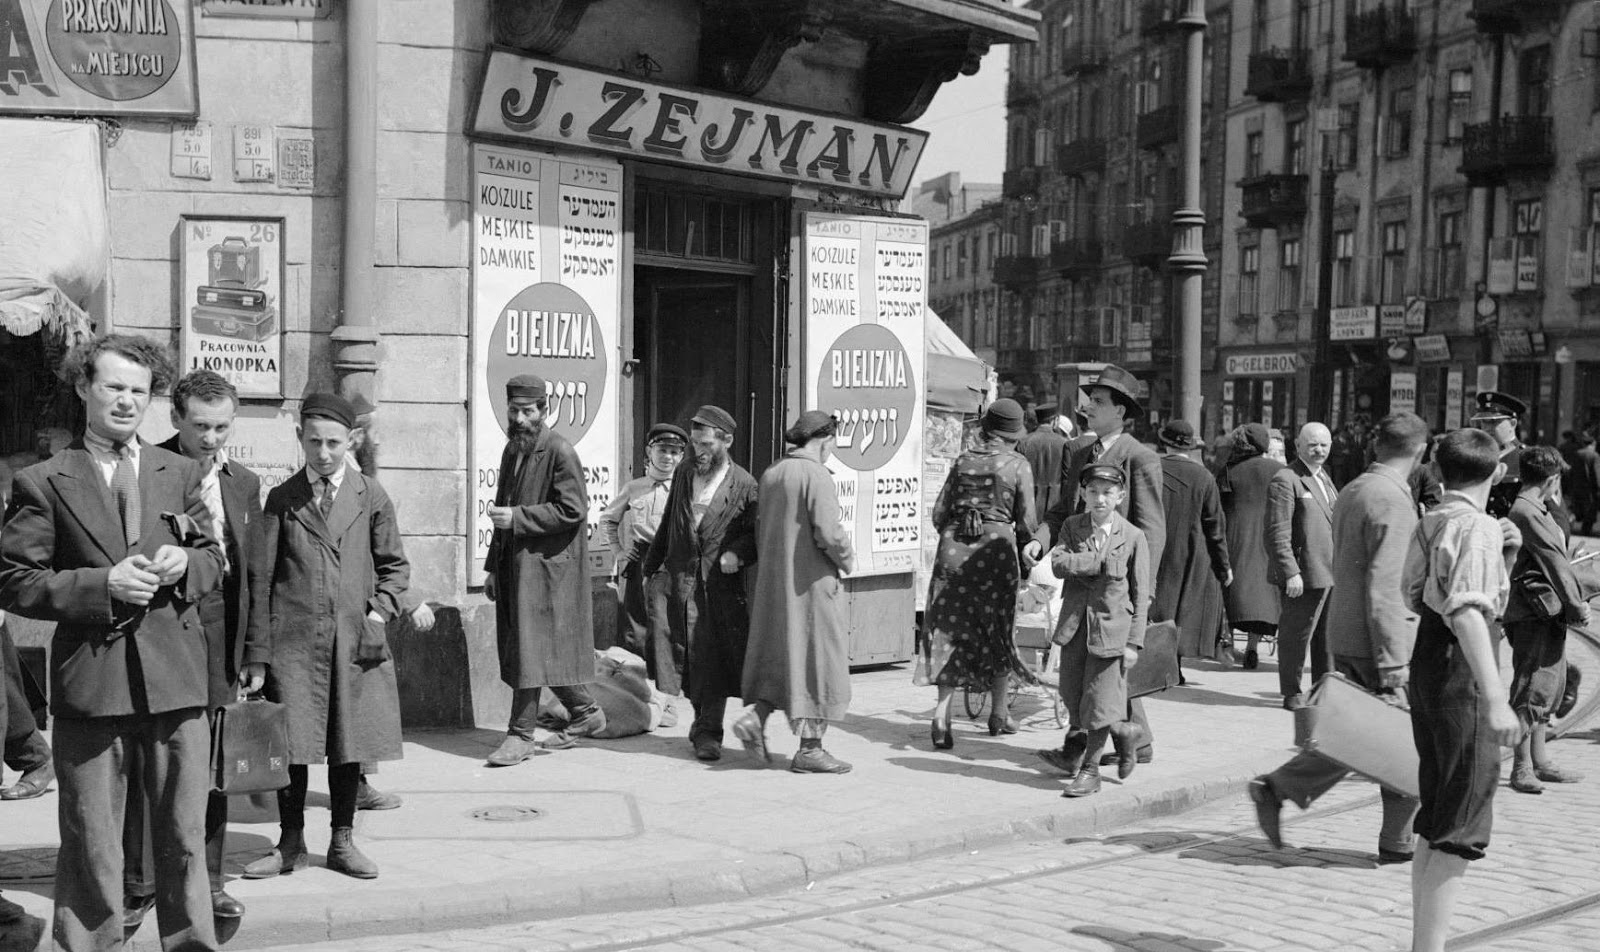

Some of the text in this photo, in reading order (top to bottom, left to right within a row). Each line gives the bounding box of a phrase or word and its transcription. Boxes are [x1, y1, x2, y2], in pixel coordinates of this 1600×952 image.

[61, 0, 168, 34] PRACOWNIA
[71, 52, 164, 76] NA MIEJSCU
[587, 80, 908, 189] ZEJMAN
[487, 155, 532, 174] TANIO
[480, 184, 534, 211] KOSZULE
[562, 195, 617, 219] העמדער
[250, 224, 275, 243] 26
[481, 215, 535, 240] MĘSKIE
[563, 224, 615, 250] מענסקע
[815, 221, 852, 234] TANIO
[480, 246, 536, 271] DAMSKIE
[811, 246, 856, 265] KOSZULE
[811, 272, 855, 291] MĘSKIE
[812, 297, 856, 316] DAMSKIE
[506, 309, 596, 359] BIELIZNA
[200, 340, 267, 354] PRACOWNIA
[203, 356, 277, 373] KONOPKA
[832, 349, 908, 389] BIELIZNA
[545, 380, 588, 430] ווע
[834, 407, 898, 456] וועש
